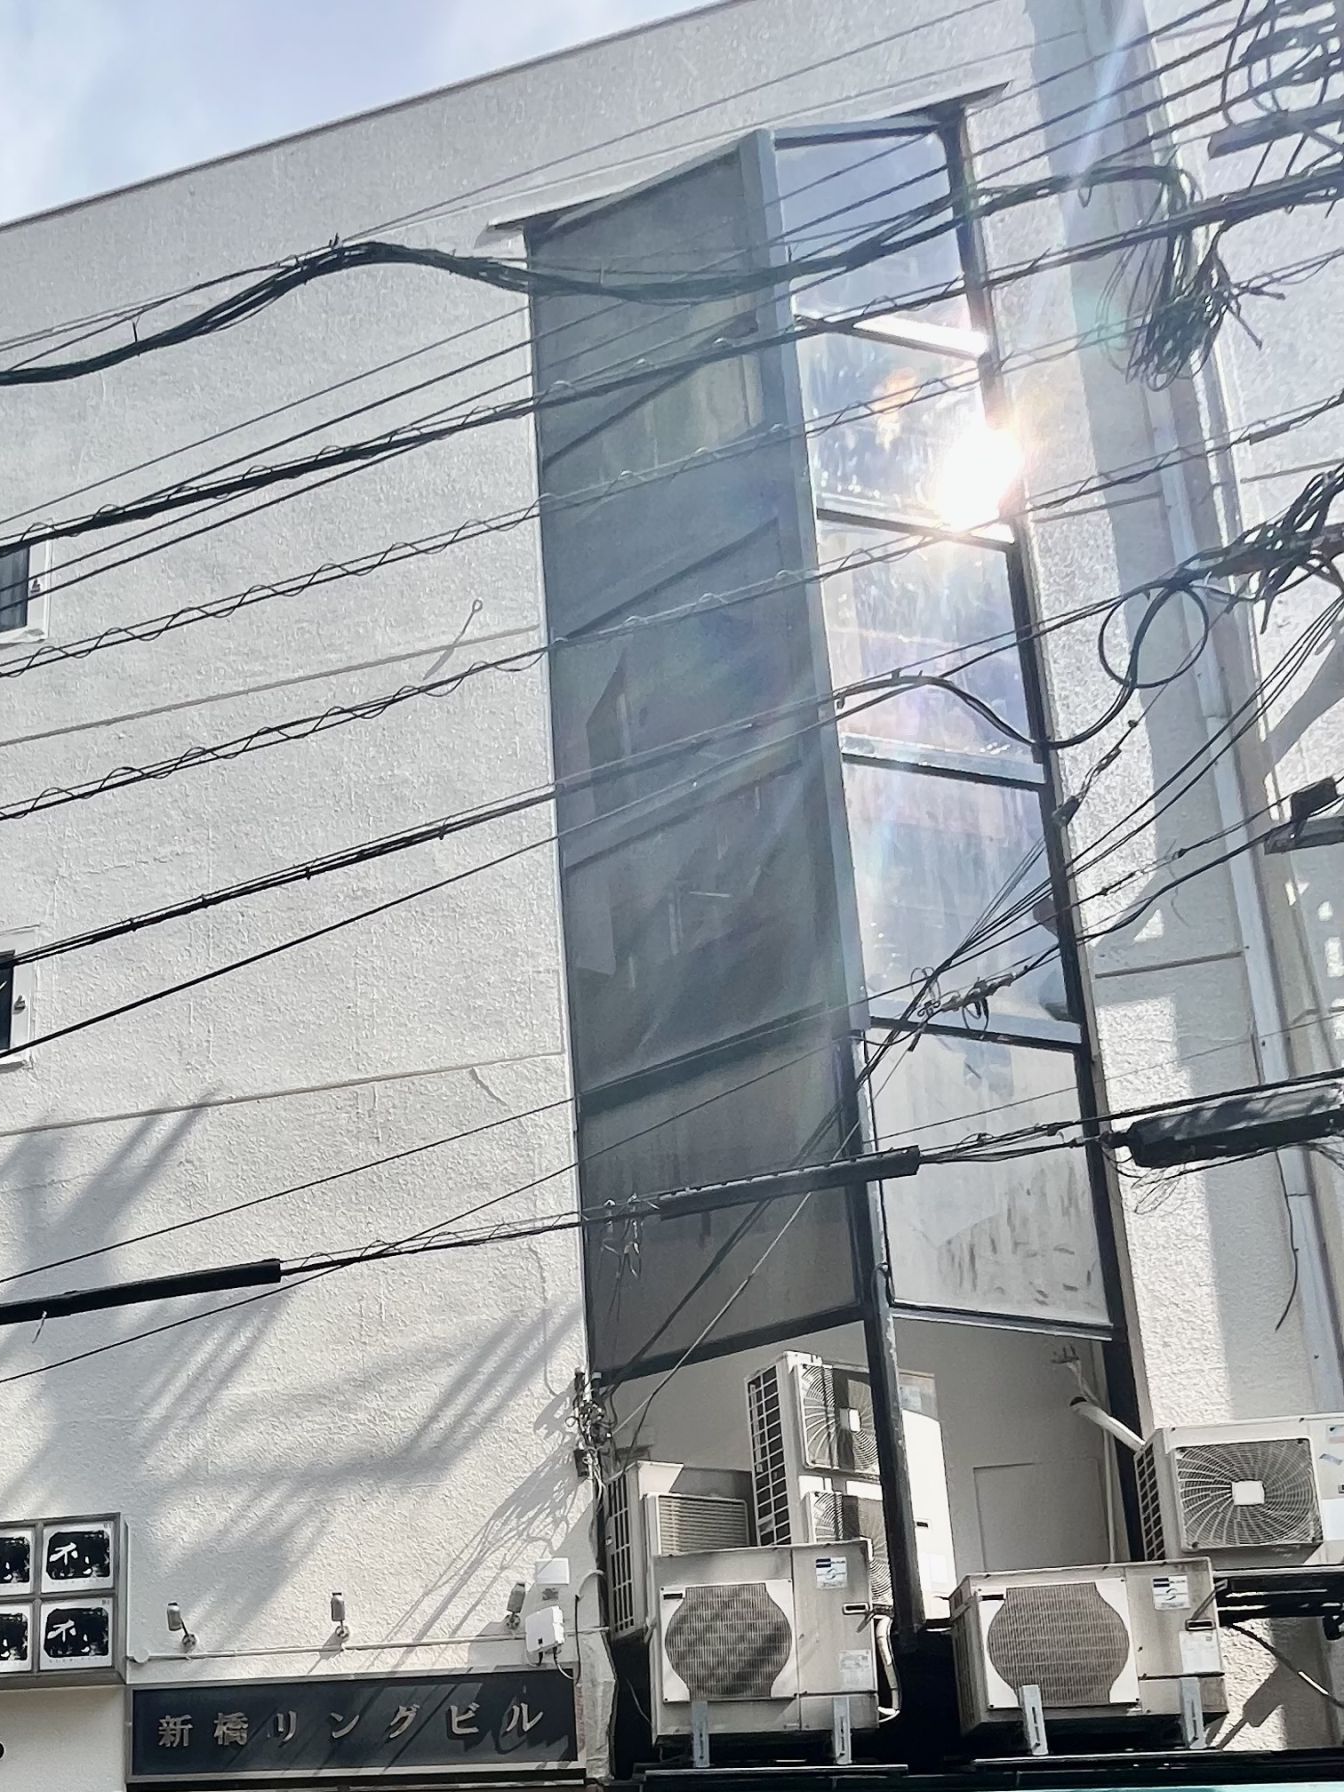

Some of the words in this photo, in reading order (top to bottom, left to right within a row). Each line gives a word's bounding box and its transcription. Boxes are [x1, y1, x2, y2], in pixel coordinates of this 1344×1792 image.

[157, 1702, 544, 1748] 新橋リングビル
